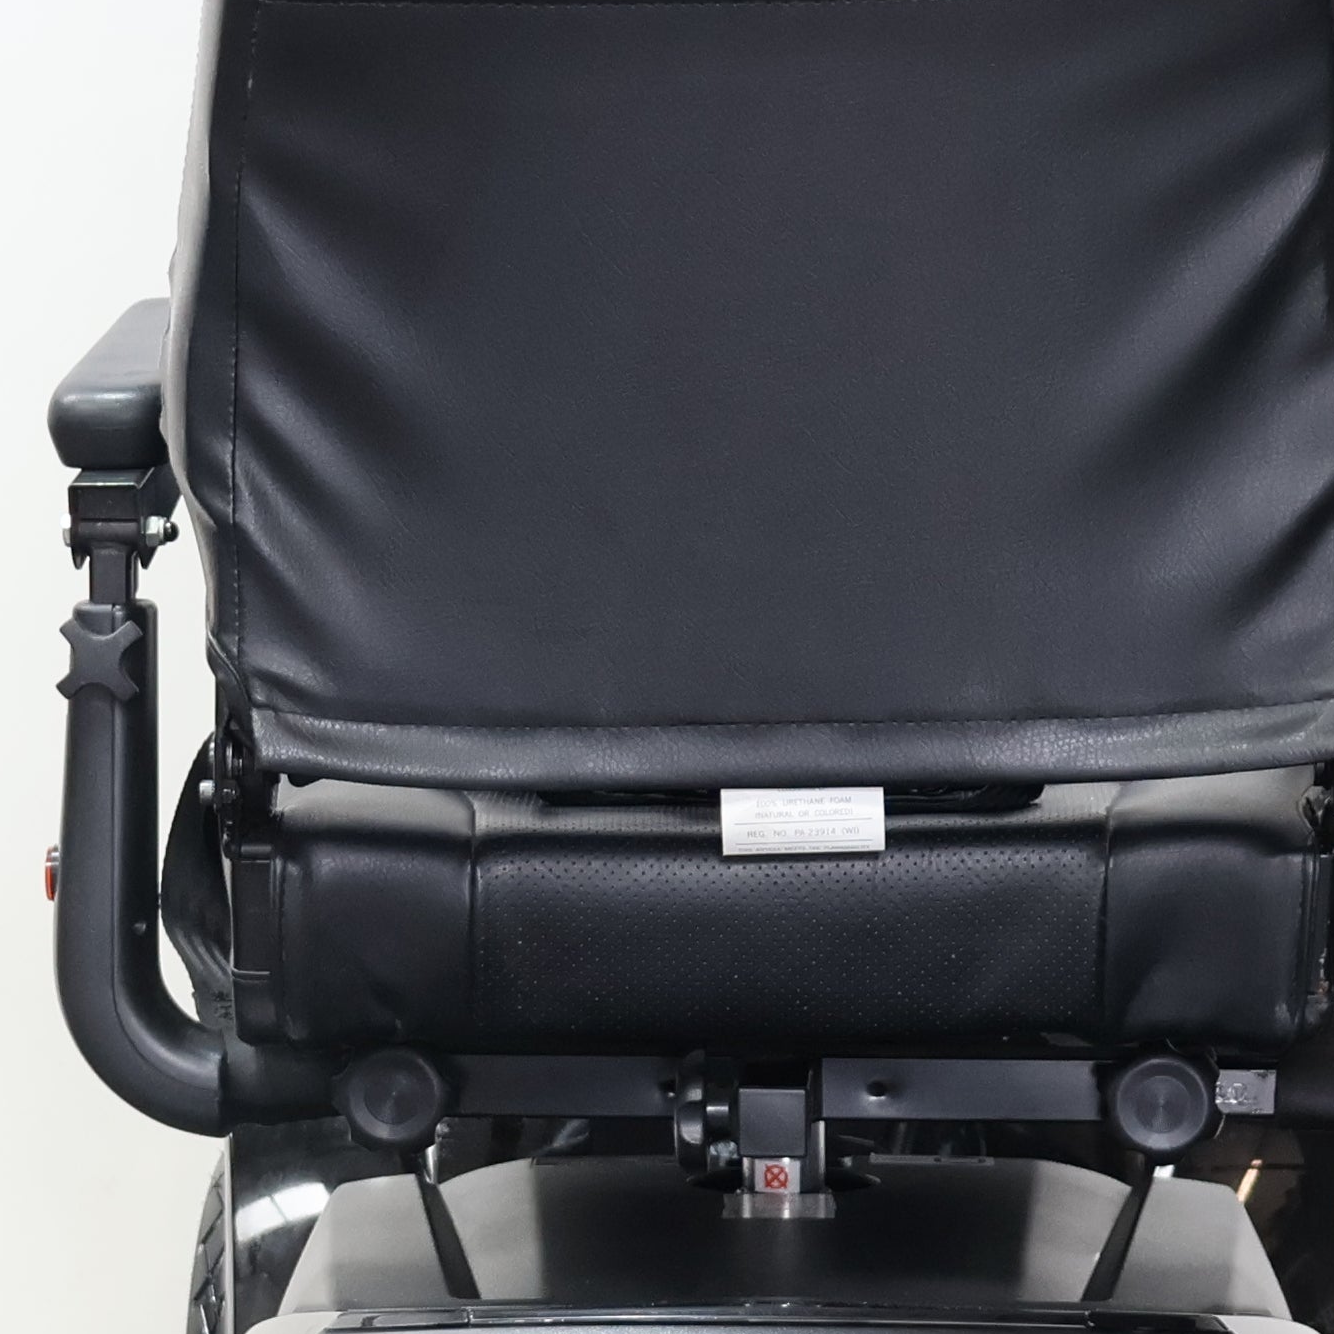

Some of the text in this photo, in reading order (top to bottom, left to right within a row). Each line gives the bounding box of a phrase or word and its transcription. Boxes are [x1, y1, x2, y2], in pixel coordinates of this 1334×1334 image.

[782, 797, 824, 807] URETHANE
[829, 796, 852, 804] FOAM
[798, 809, 809, 817] OR
